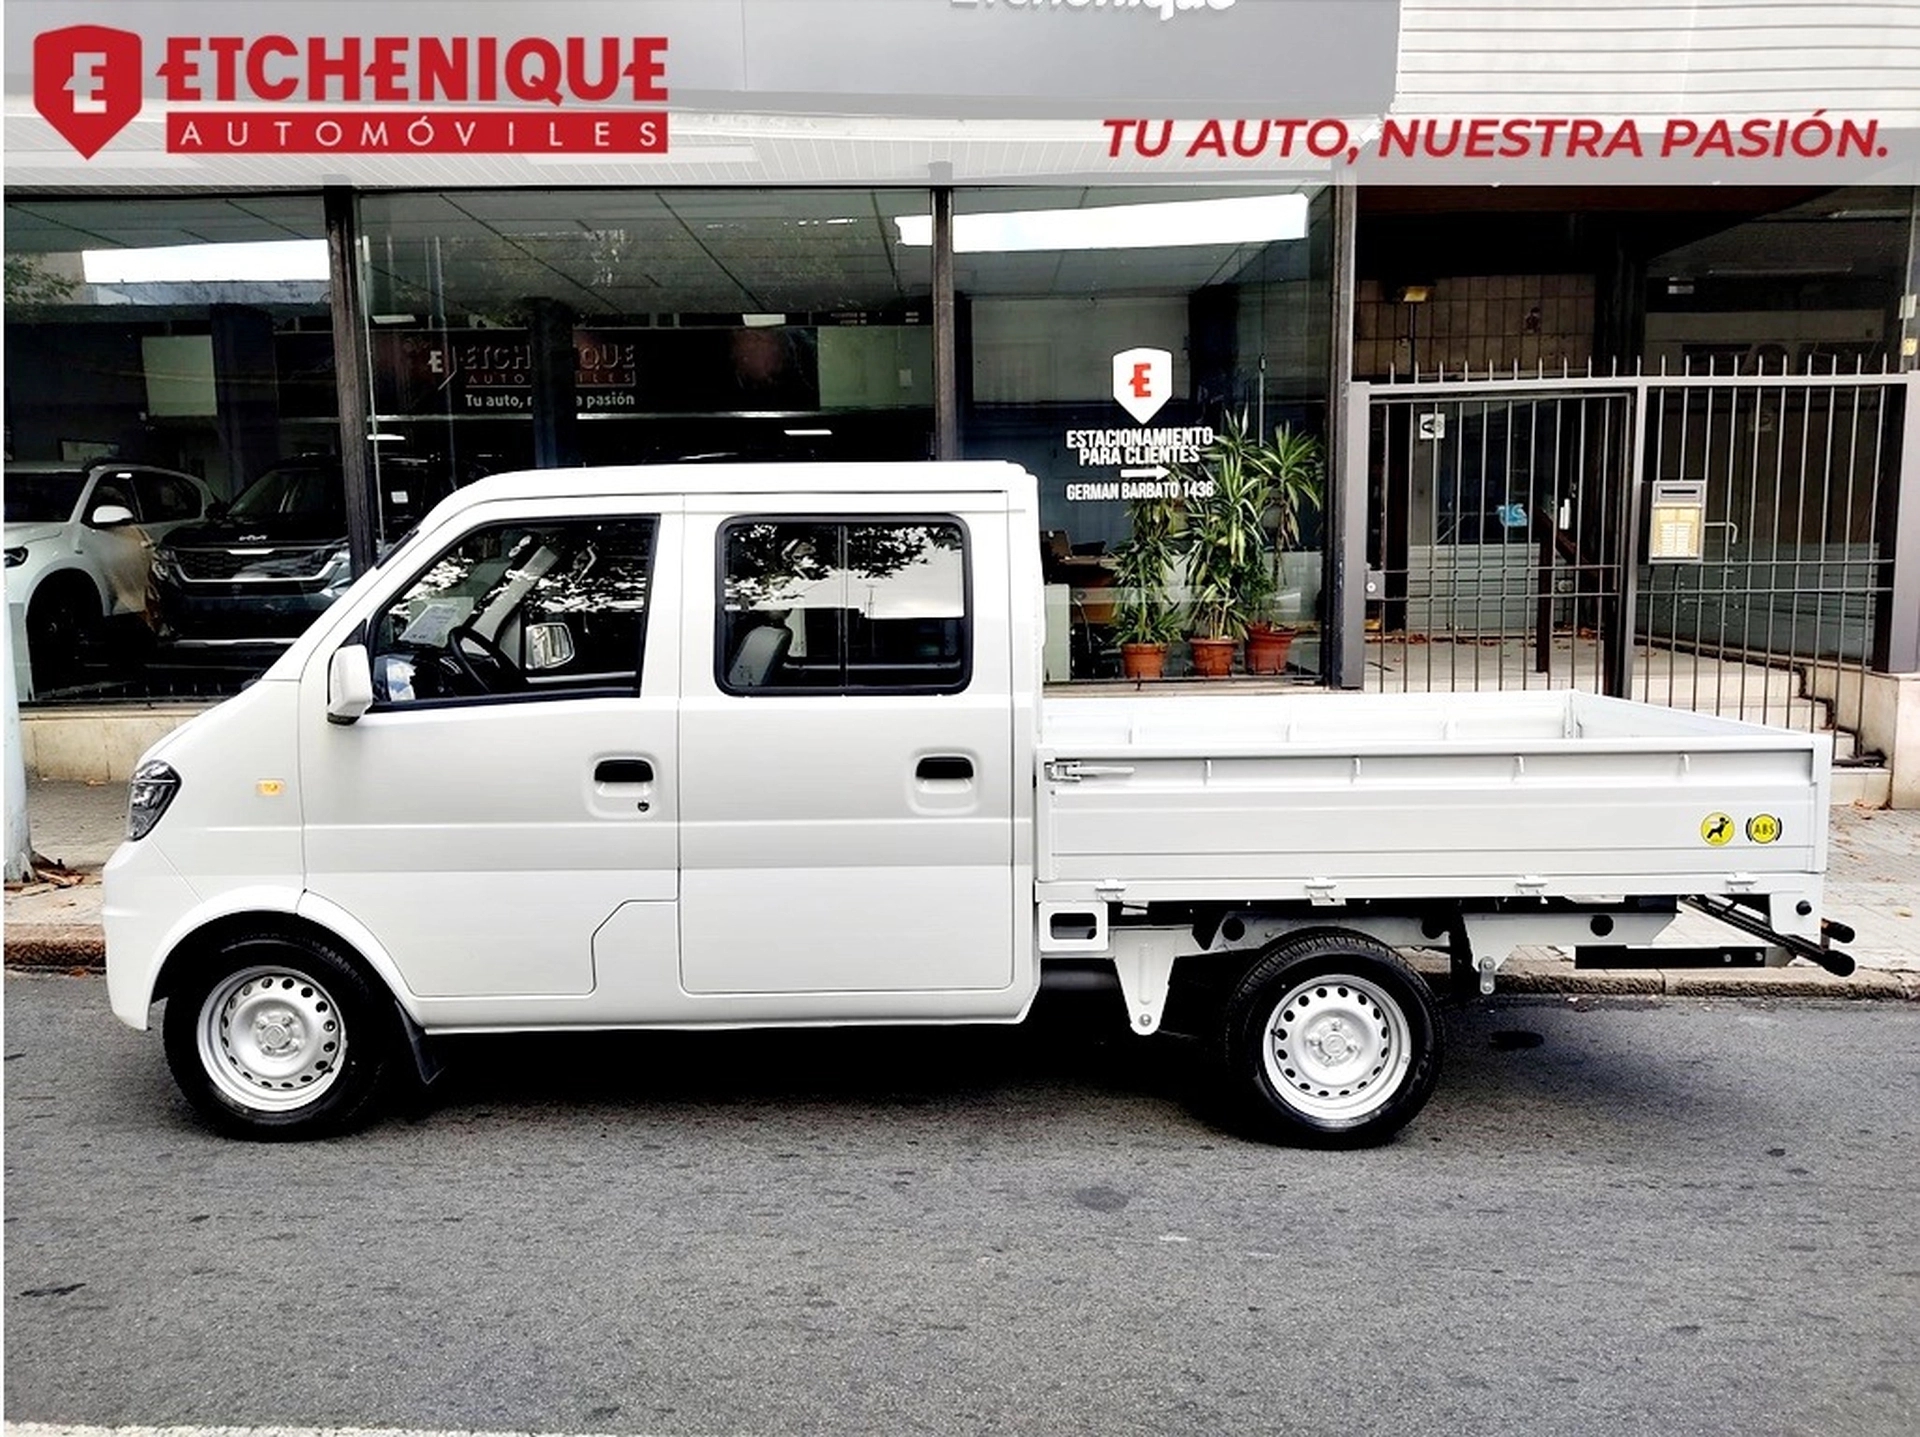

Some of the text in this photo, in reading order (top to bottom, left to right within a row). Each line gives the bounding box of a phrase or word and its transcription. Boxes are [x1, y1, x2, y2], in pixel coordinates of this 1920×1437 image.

[465, 394, 482, 407] Tu
[486, 394, 524, 409] auto,
[587, 391, 635, 409] pasión
[1066, 427, 1214, 449] ESTACIONAMIENTO
[1079, 446, 1200, 466] PARA CLIENTES
[1066, 483, 1119, 500] GERMAN
[1121, 481, 1179, 499] BARBATO
[1753, 822, 1775, 836] ABS
